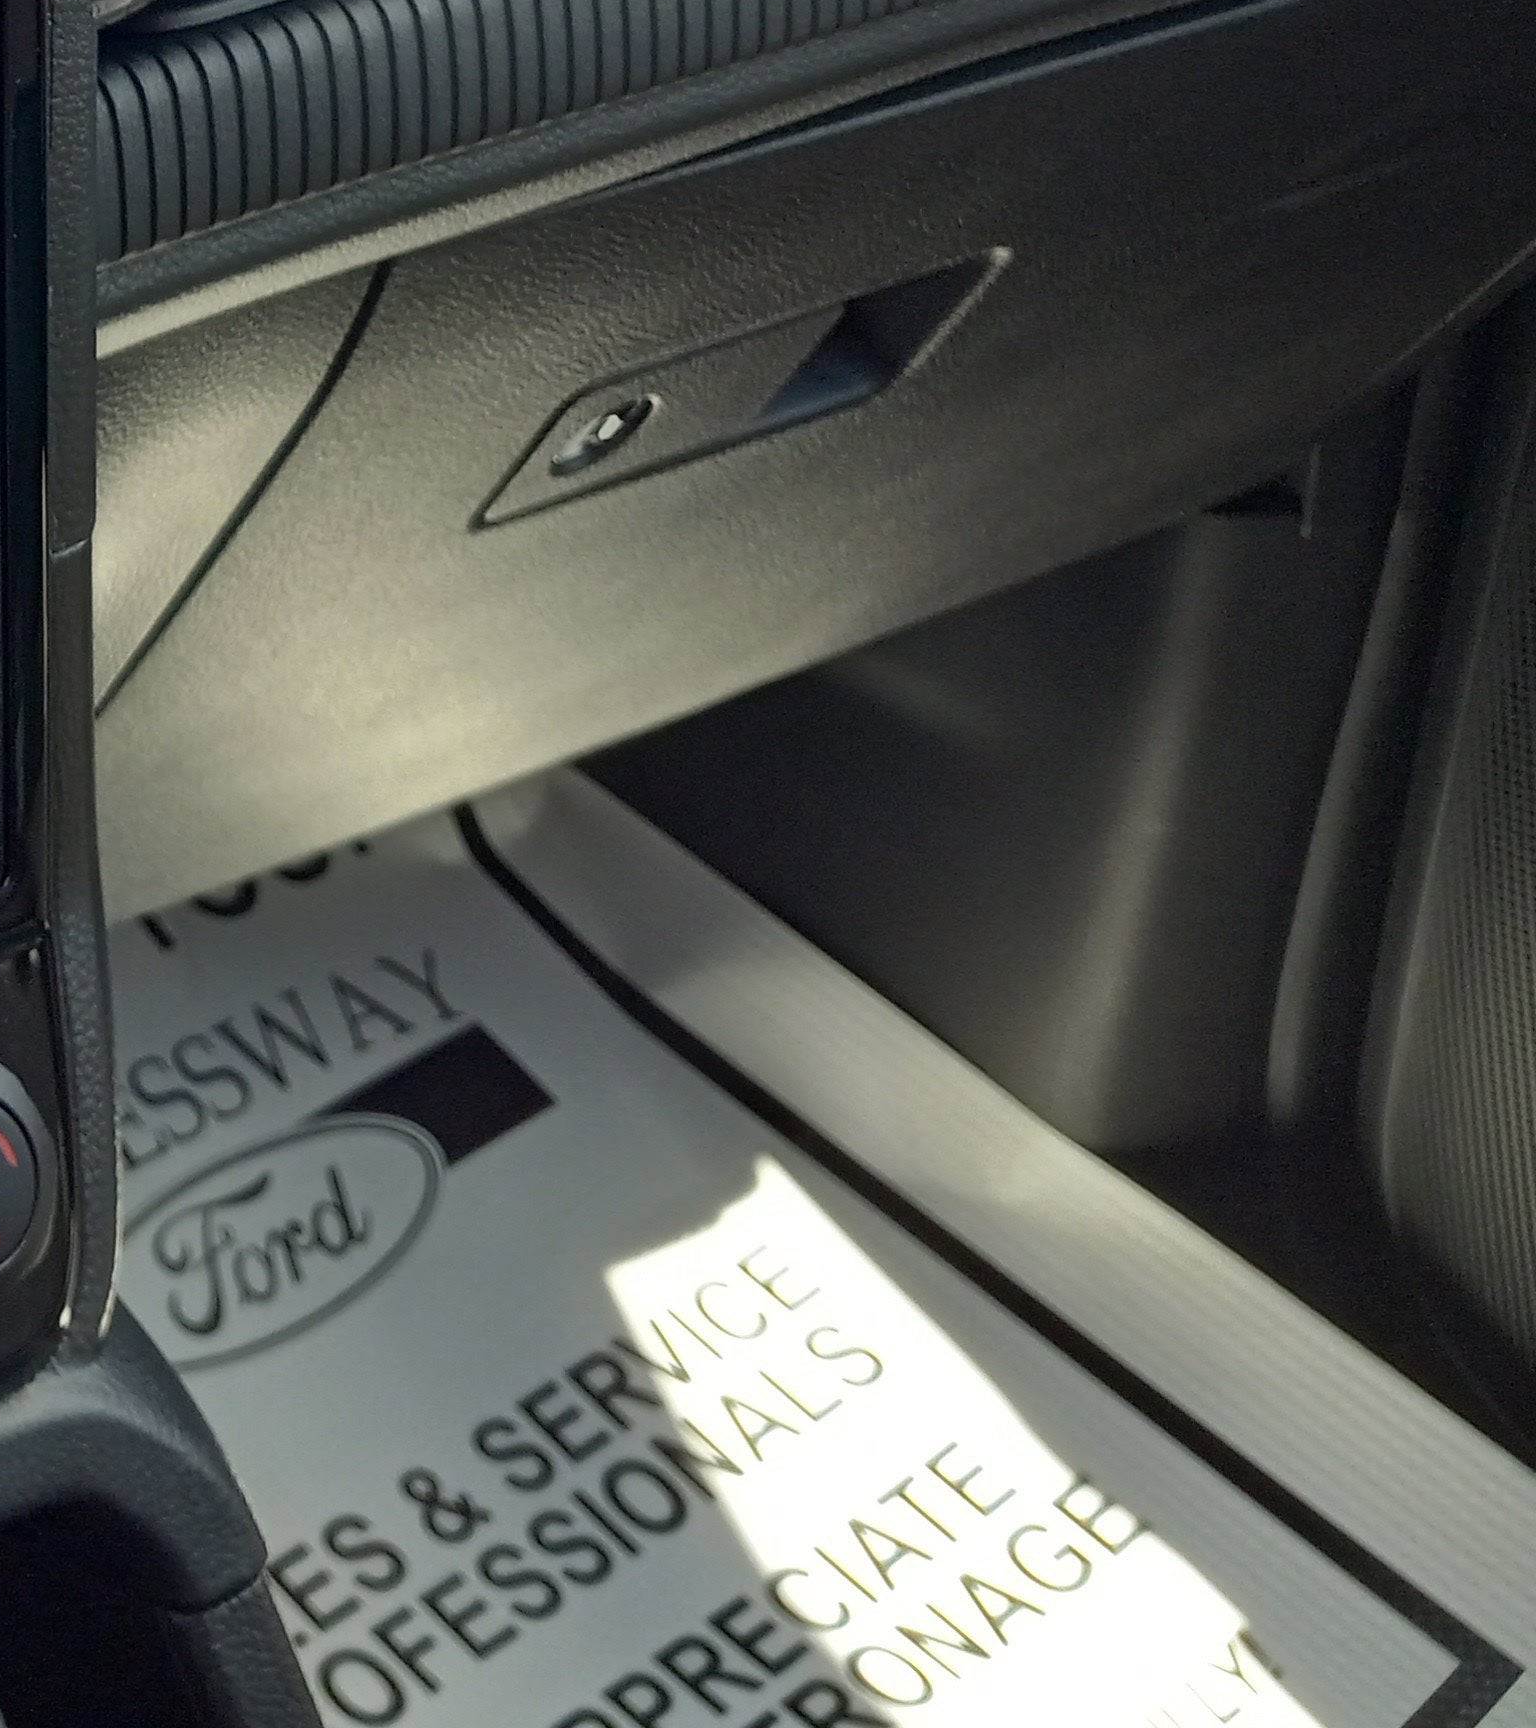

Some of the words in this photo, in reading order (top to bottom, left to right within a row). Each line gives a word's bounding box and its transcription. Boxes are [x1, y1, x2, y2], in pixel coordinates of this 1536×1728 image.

[152, 1164, 374, 1336] Ford
[267, 1513, 406, 1648] ES
[398, 1466, 491, 1544] &
[470, 1242, 822, 1492] SERVICE
